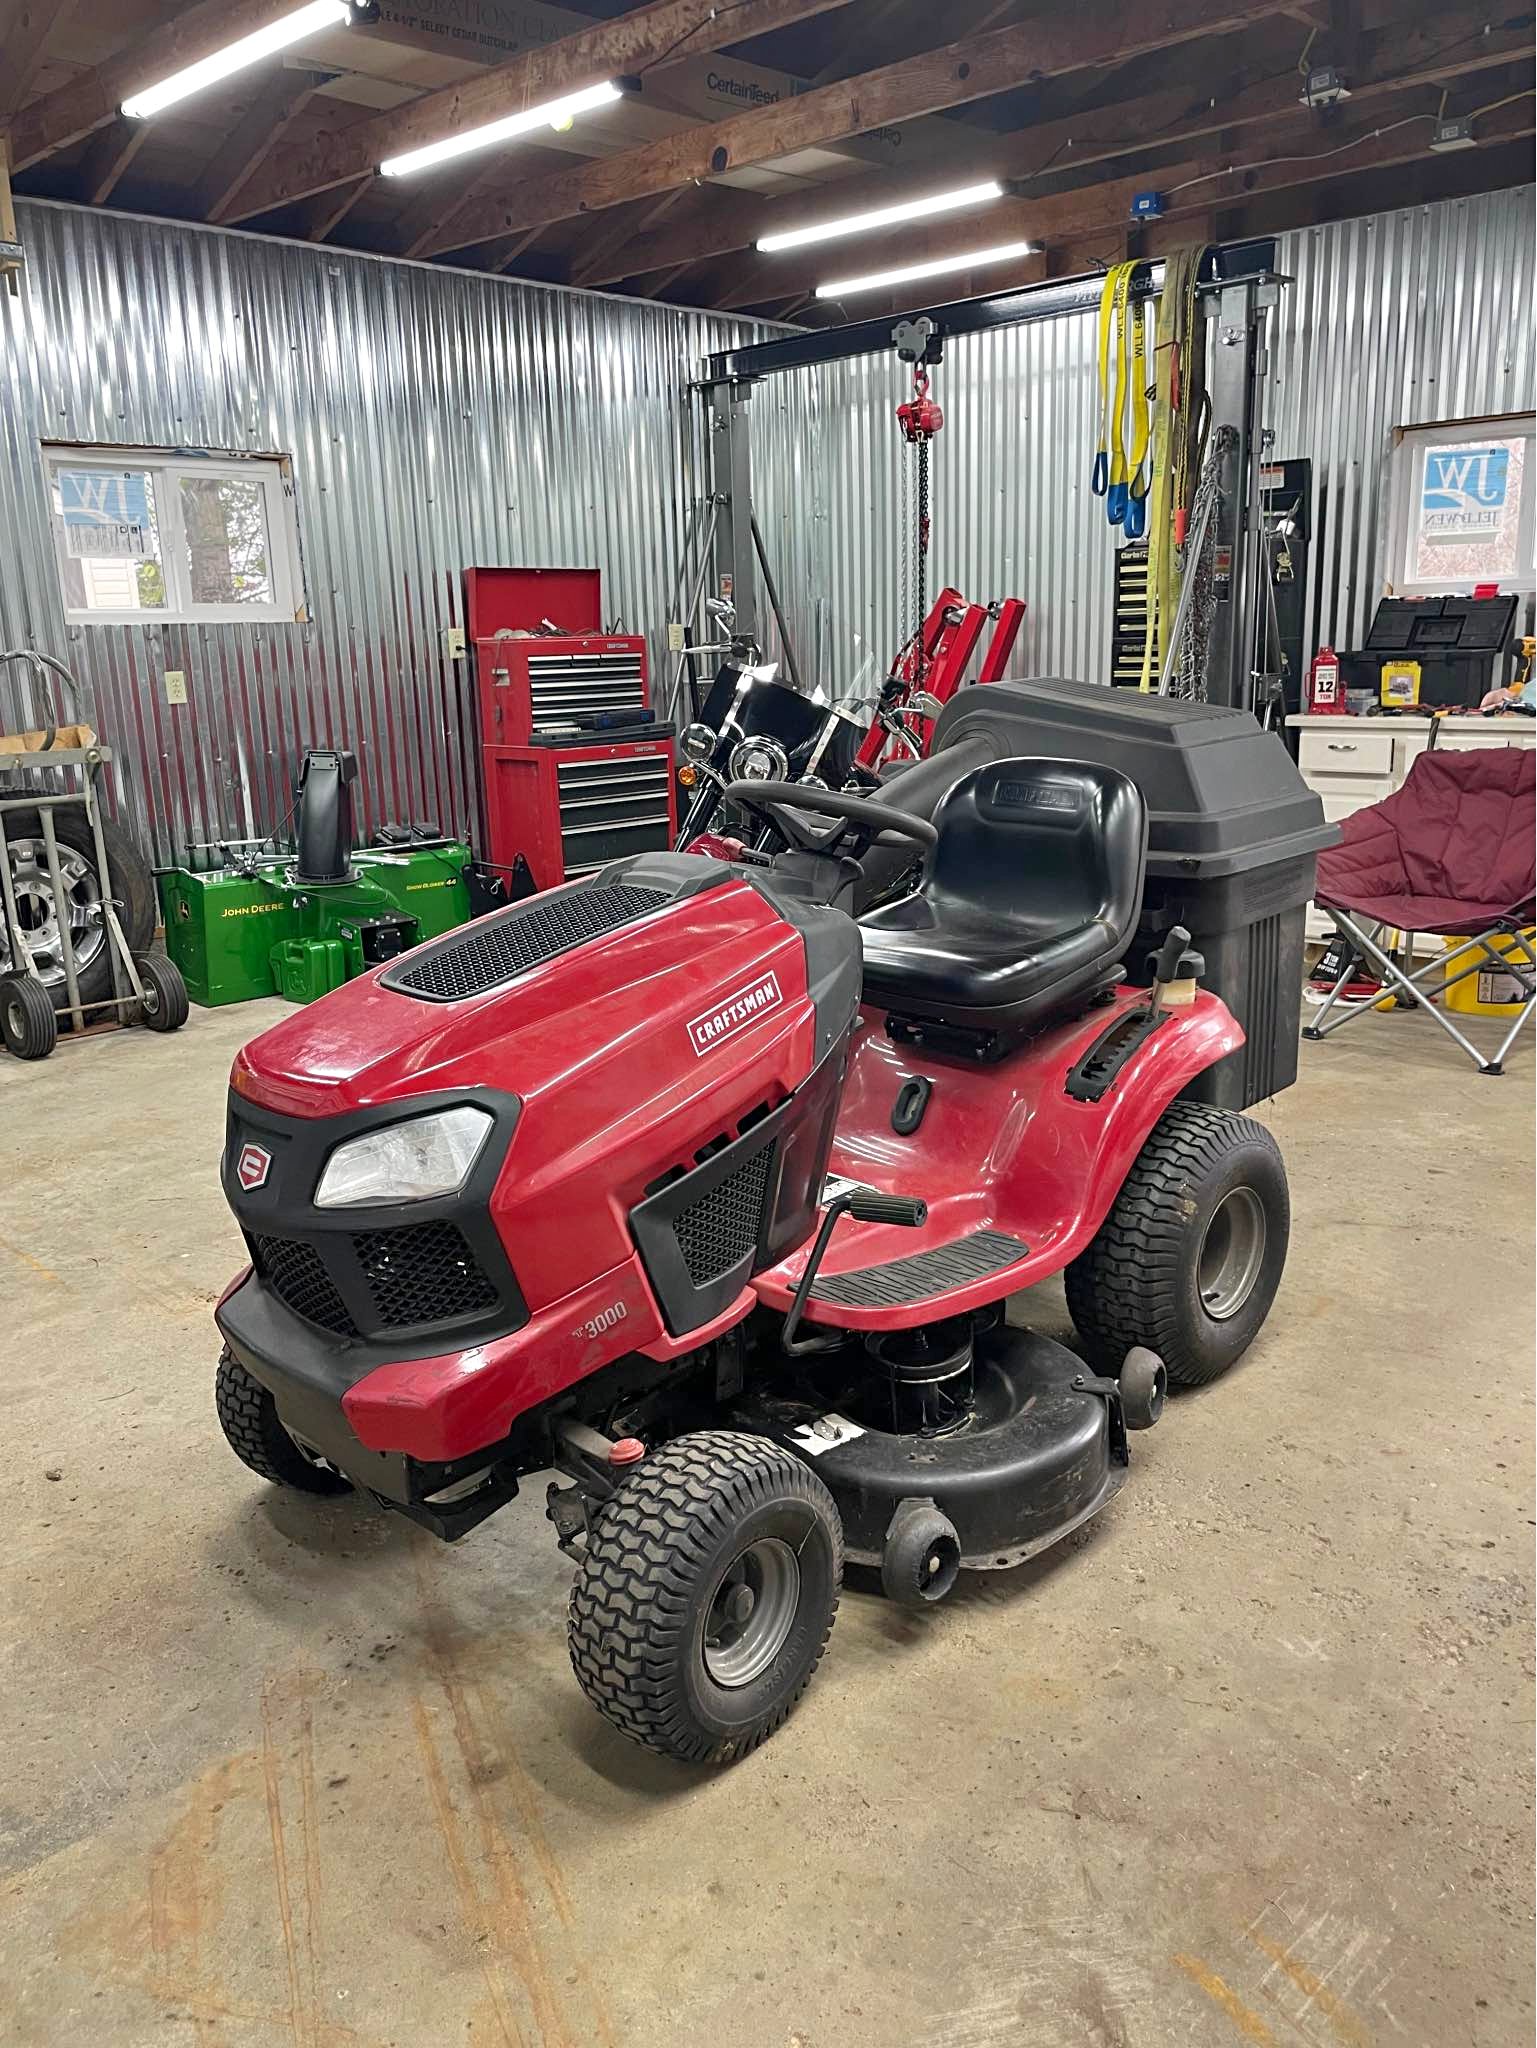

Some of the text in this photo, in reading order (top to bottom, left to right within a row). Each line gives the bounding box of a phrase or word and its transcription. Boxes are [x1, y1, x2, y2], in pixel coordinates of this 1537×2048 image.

[707, 72, 779, 103] CertainTeed
[1134, 333, 1143, 358] WLL
[1318, 681, 1333, 693] 12
[221, 902, 285, 917] JOHN DEERE
[1323, 952, 1332, 964] 3
[696, 982, 775, 1044] CRAFTSMAN
